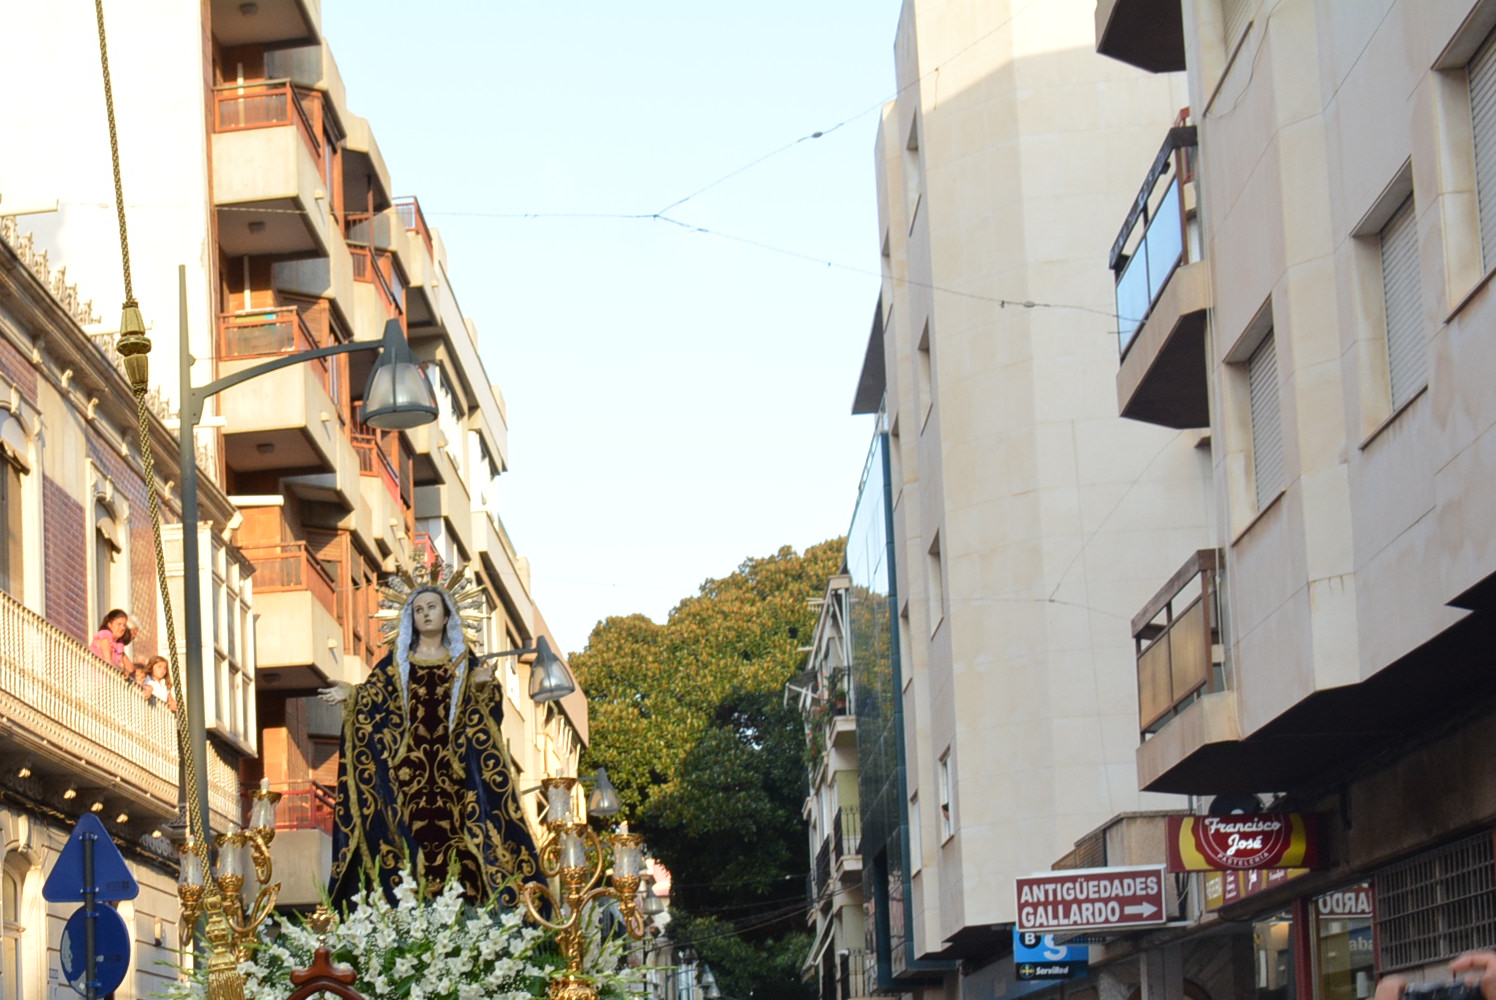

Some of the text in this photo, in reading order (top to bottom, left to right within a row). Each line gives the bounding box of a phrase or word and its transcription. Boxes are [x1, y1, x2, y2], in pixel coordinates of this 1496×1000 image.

[1205, 817, 1281, 834] Francisco
[1227, 834, 1263, 856] José
[1020, 877, 1159, 903] ANTIGÜEDADES
[1021, 901, 1120, 927] GALLARDO
[1024, 932, 1036, 945] B
